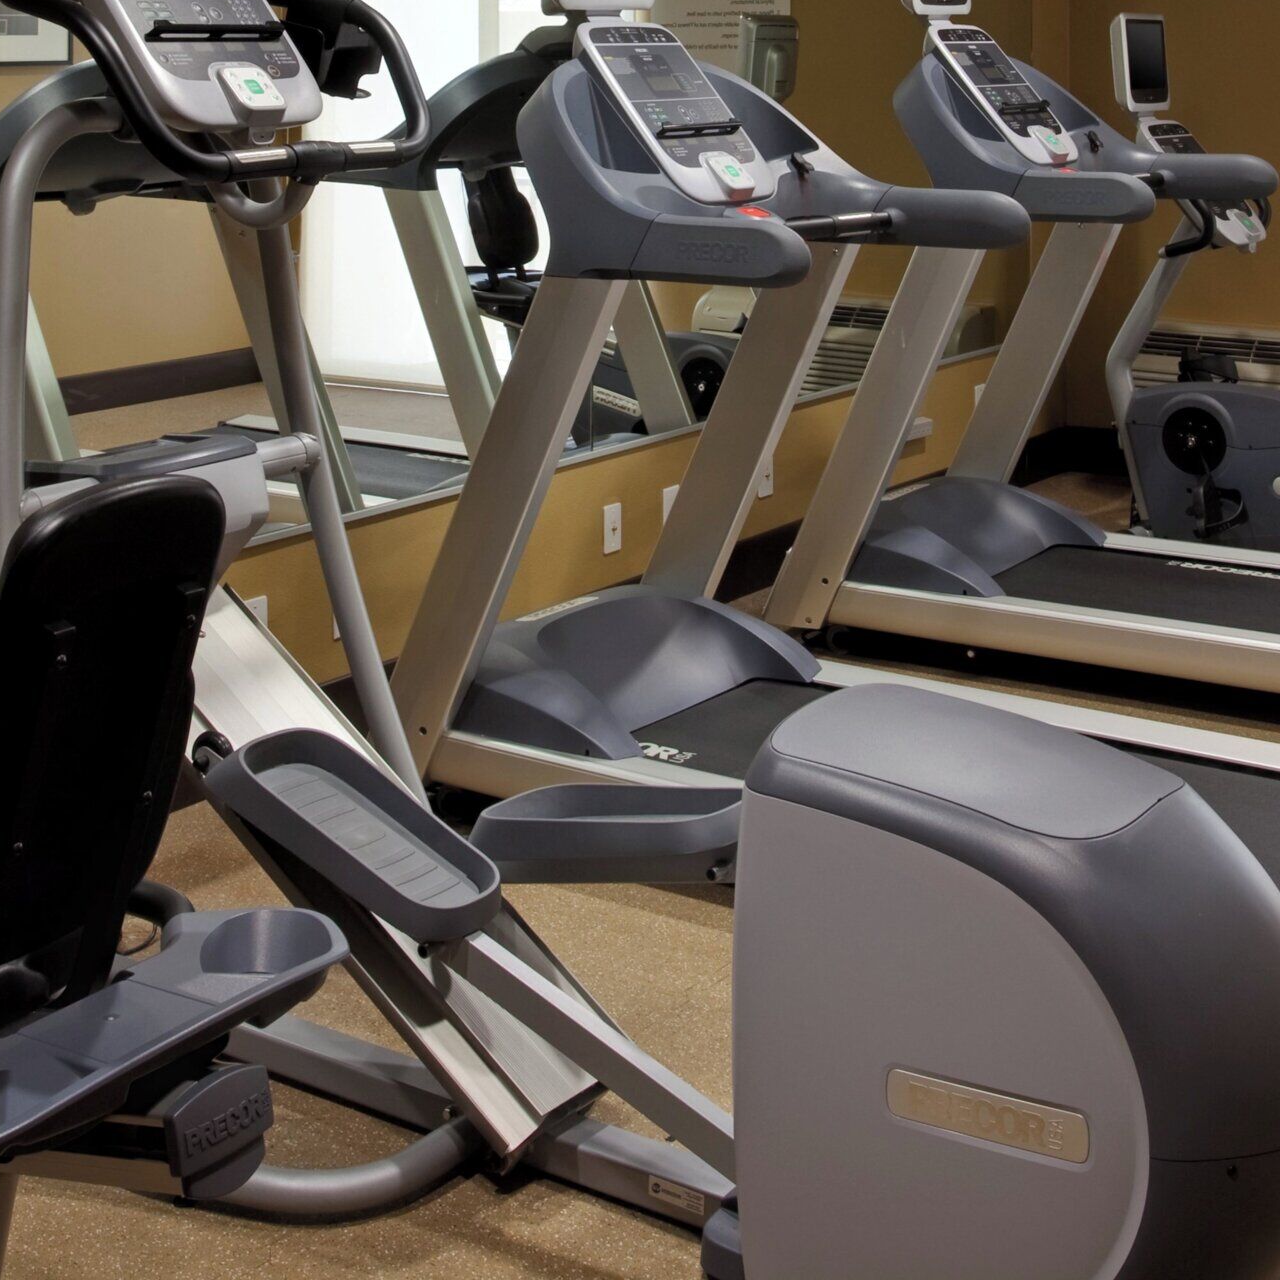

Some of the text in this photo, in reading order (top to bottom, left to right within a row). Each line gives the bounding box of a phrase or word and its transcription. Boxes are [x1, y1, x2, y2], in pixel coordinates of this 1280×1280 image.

[184, 1093, 265, 1159] PRECOR
[909, 1081, 1065, 1151] PRECOR USA
